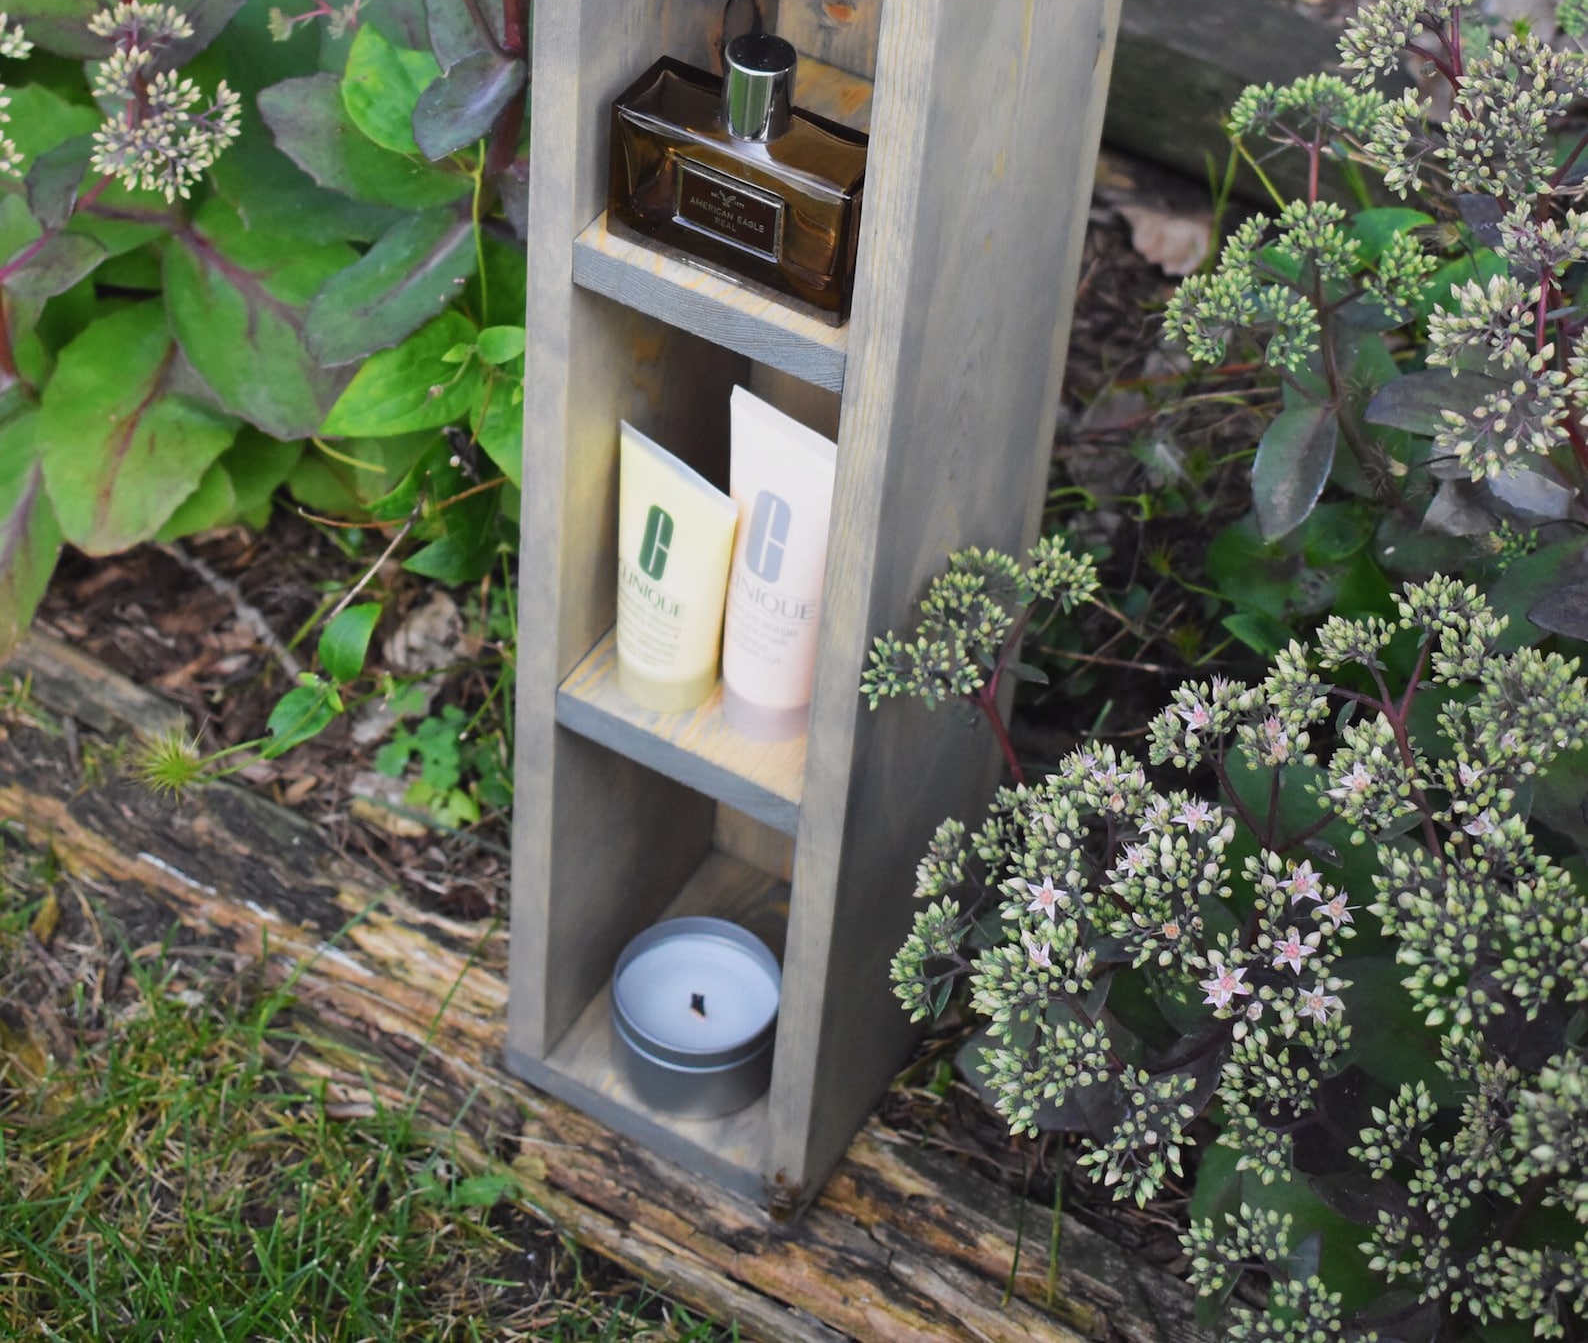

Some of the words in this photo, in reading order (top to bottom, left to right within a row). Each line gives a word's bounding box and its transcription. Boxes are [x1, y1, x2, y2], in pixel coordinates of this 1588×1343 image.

[690, 196, 734, 221] AMERICAN
[737, 216, 765, 233] EAGLE
[621, 565, 682, 618] LINIQUE
[734, 572, 816, 621] INIQUE
